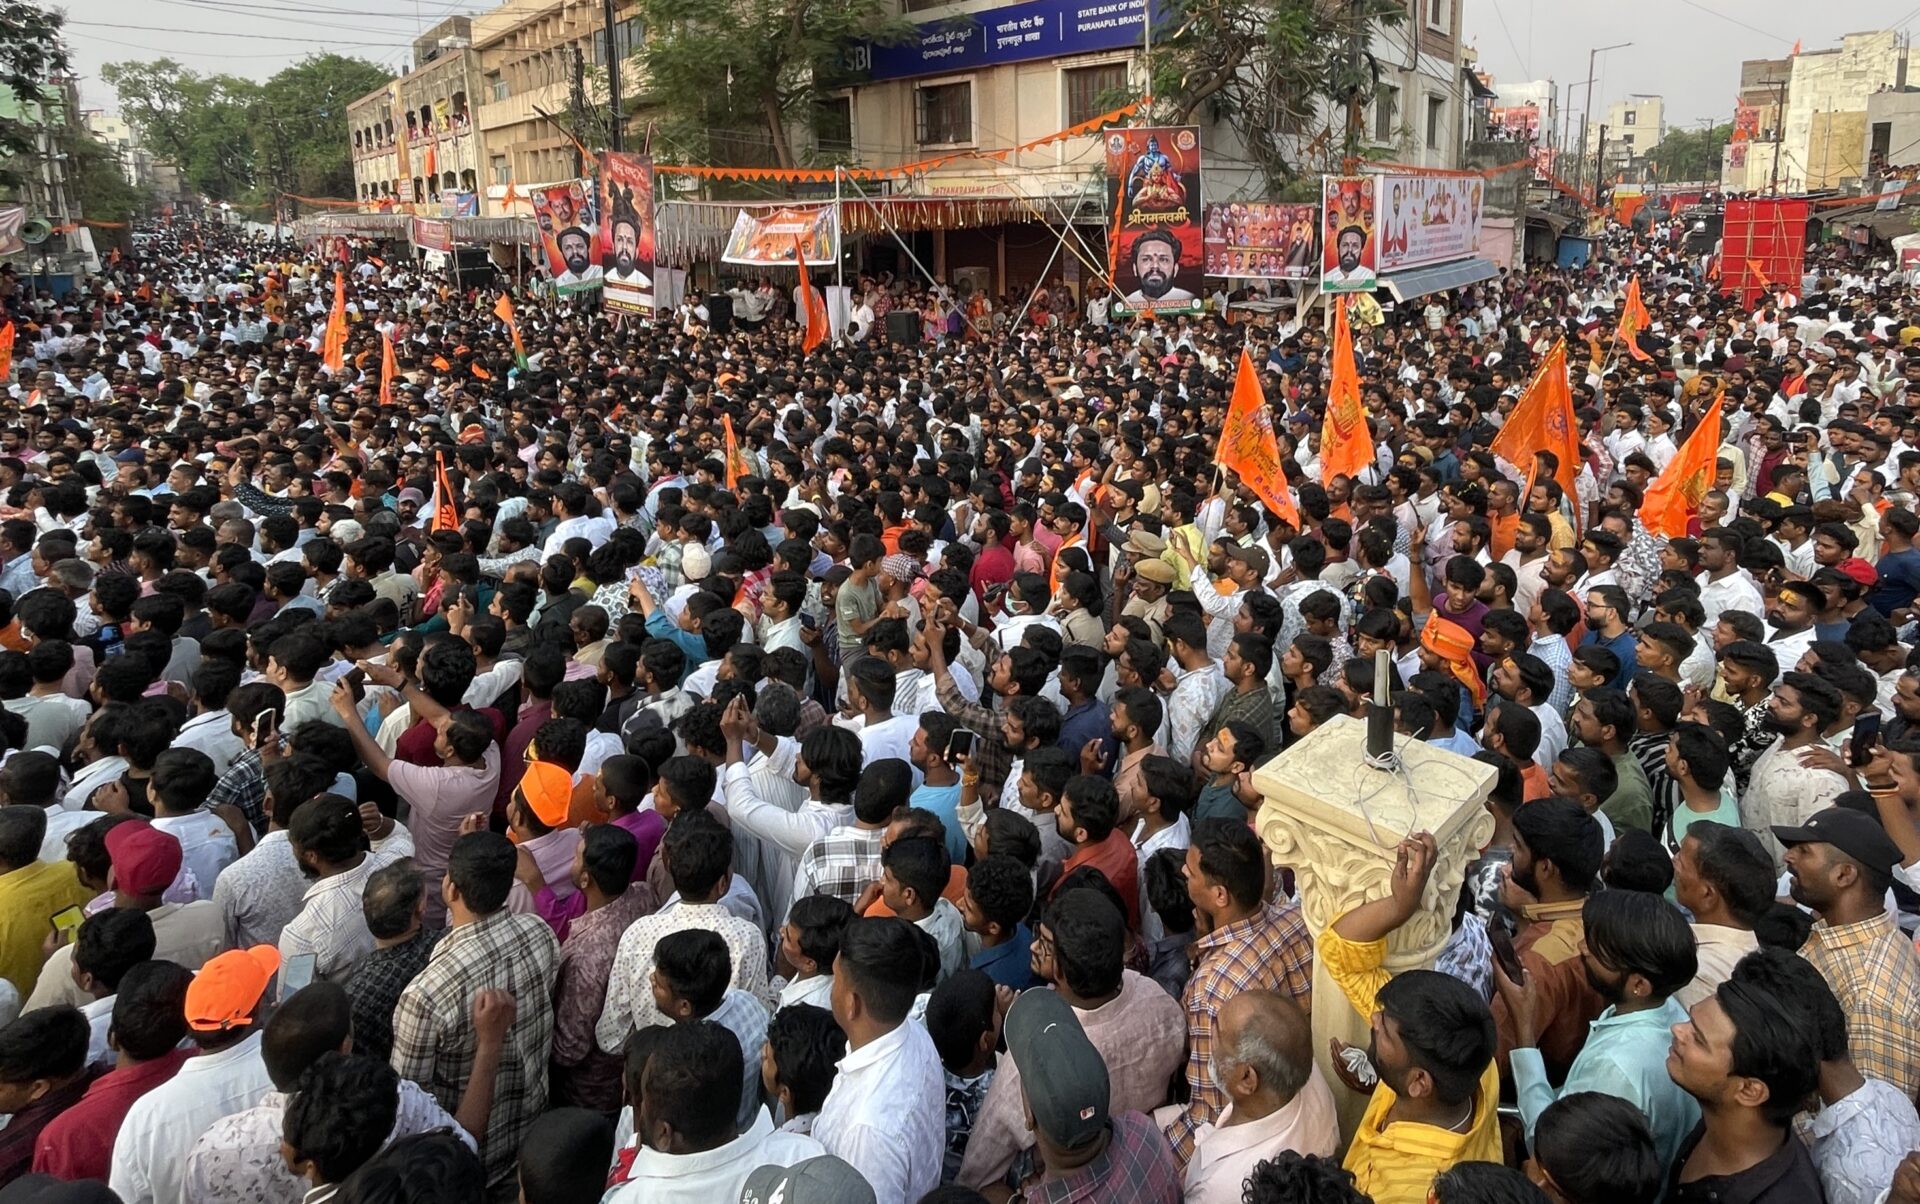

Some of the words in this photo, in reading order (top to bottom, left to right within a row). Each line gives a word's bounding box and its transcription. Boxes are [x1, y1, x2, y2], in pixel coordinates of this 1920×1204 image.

[1077, 8, 1097, 18] STATE
[1098, 4, 1117, 14] BANK
[1118, 2, 1128, 11] OF
[996, 20, 1018, 33] भारतीय
[1019, 18, 1033, 29] स्टेट
[1033, 15, 1045, 27] बैंक
[1077, 20, 1117, 32] PURANAPUL
[1125, 206, 1190, 228] श्रीरामनवमी
